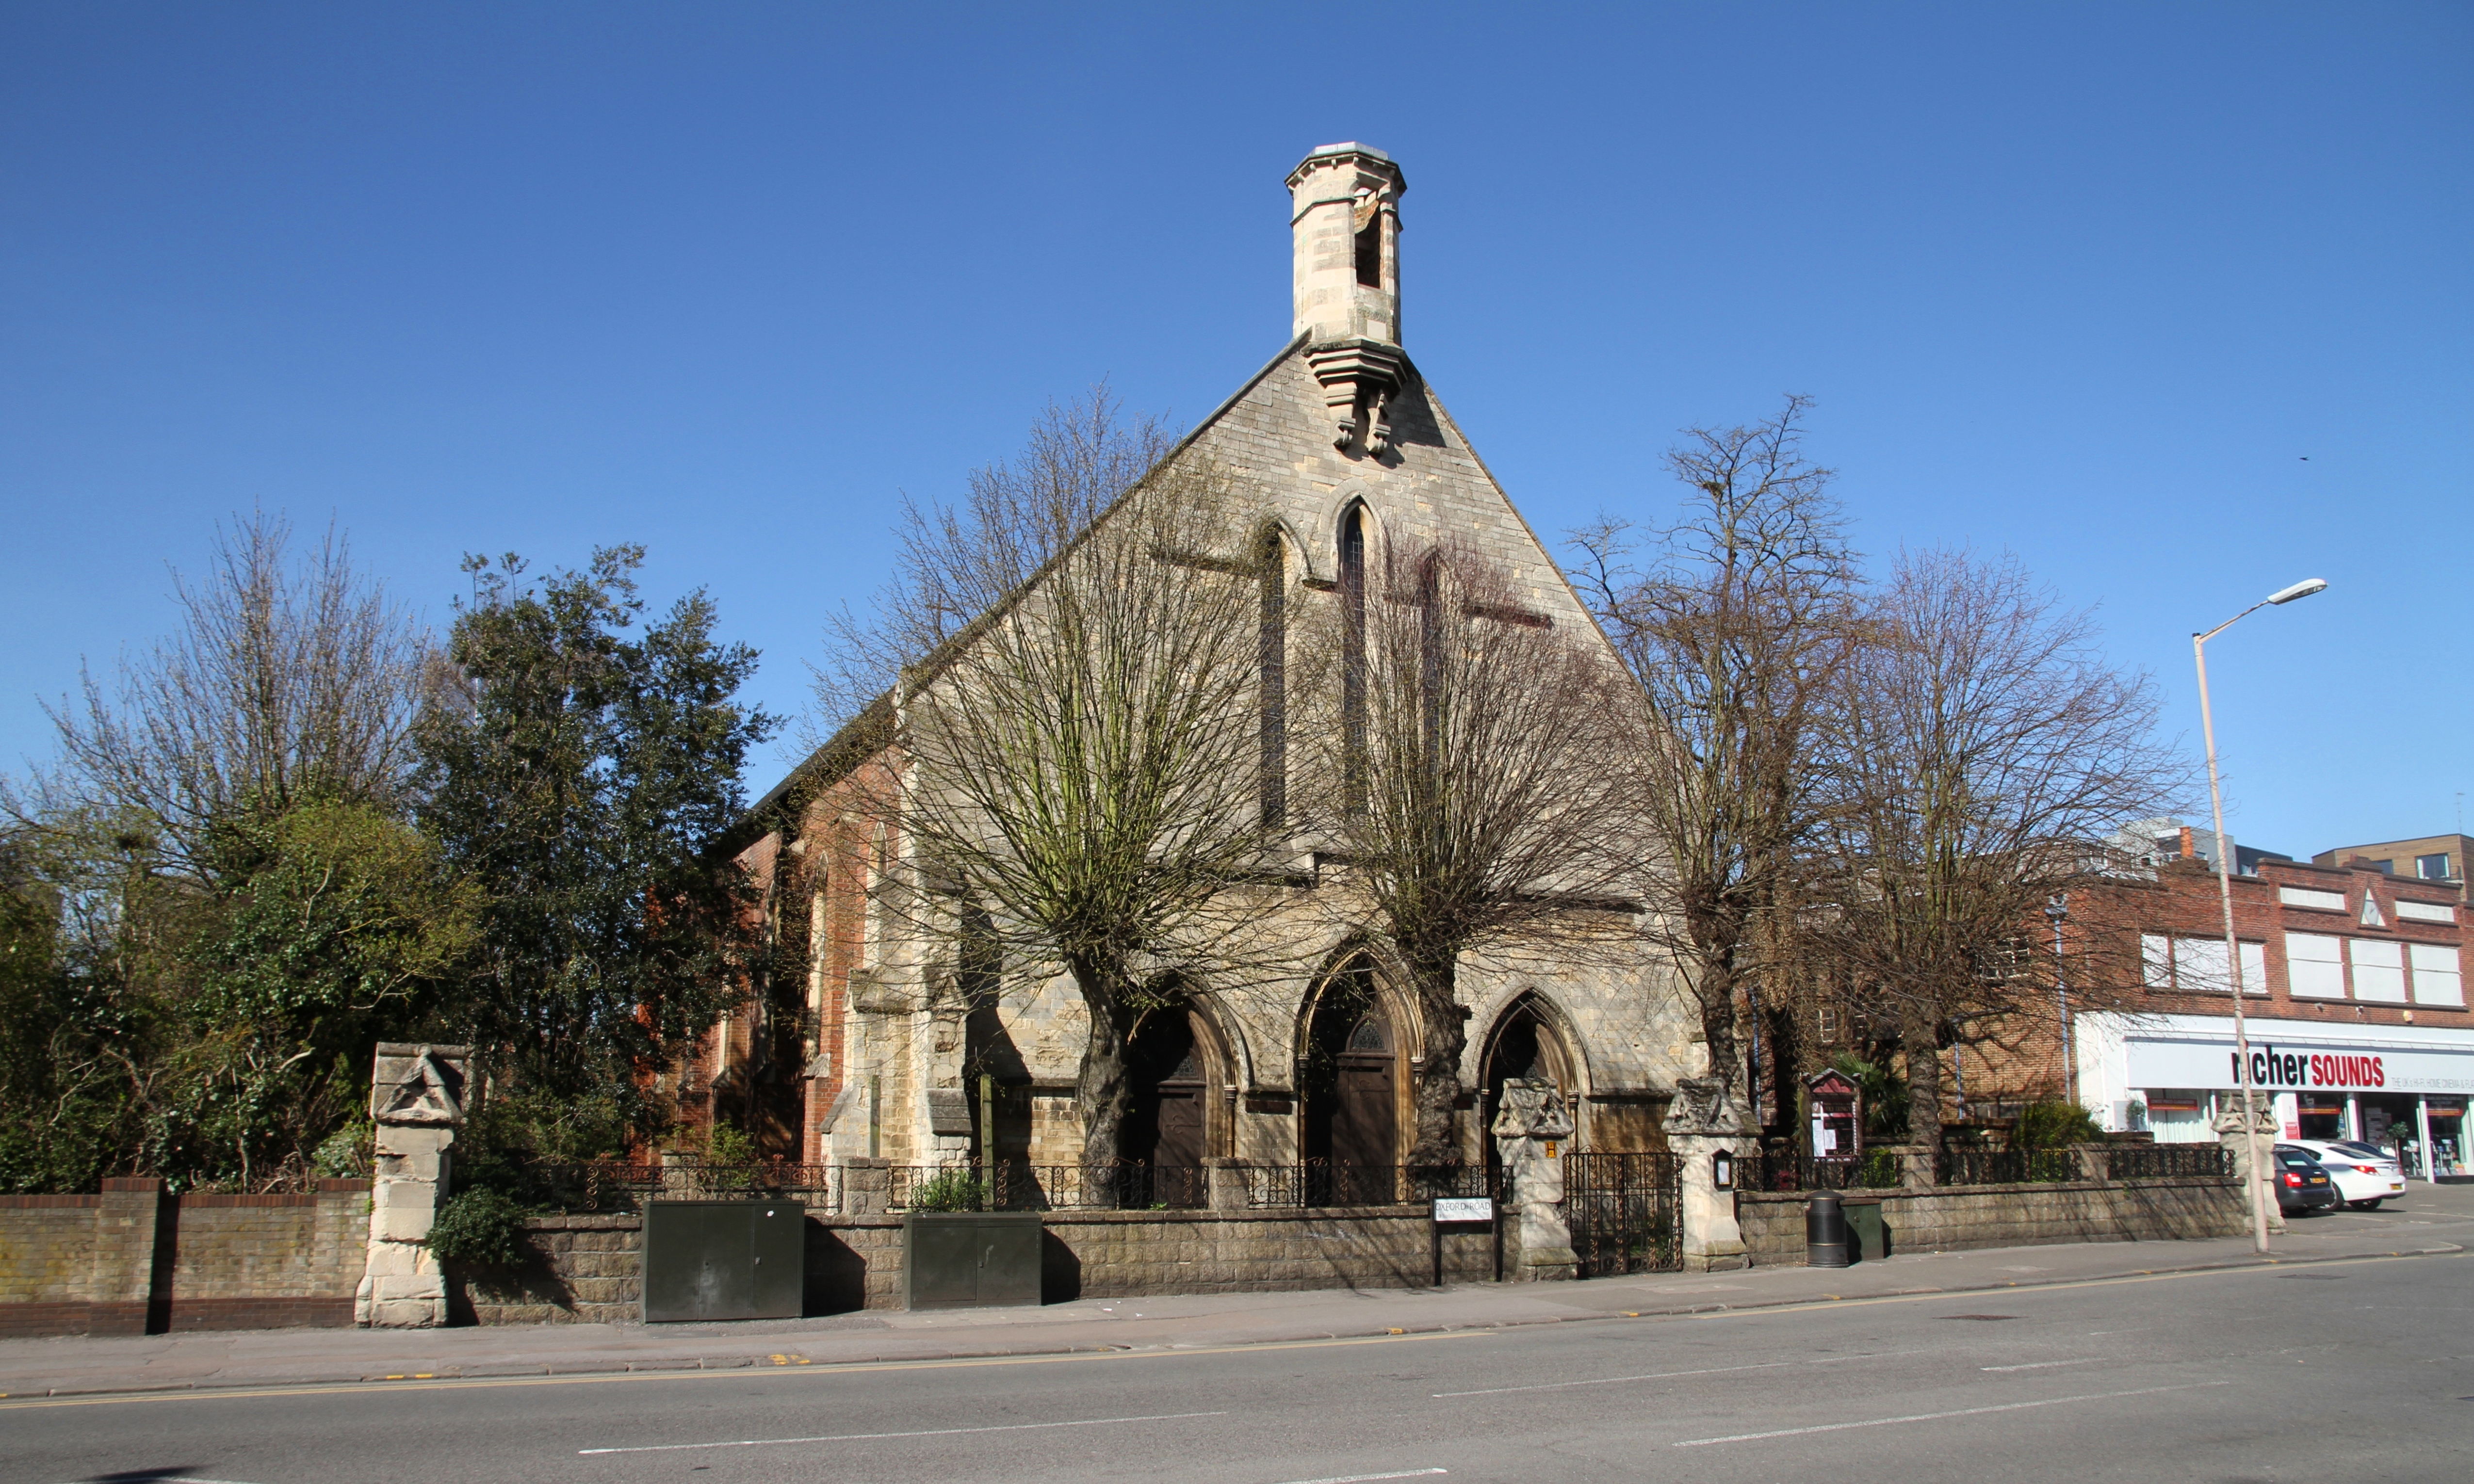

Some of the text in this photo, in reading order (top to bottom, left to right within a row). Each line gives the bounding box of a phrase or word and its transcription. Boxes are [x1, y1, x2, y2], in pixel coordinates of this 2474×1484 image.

[2311, 1054, 2384, 1087] SOUNDS
[2391, 1077, 2402, 1087] THE
[2427, 1079, 2441, 1088] HOME
[2461, 1080, 2465, 1089] &
[2465, 1079, 2474, 1089] FLA
[1547, 1143, 1556, 1156] H
[1435, 1202, 1491, 1211] OXFORD ROAD
